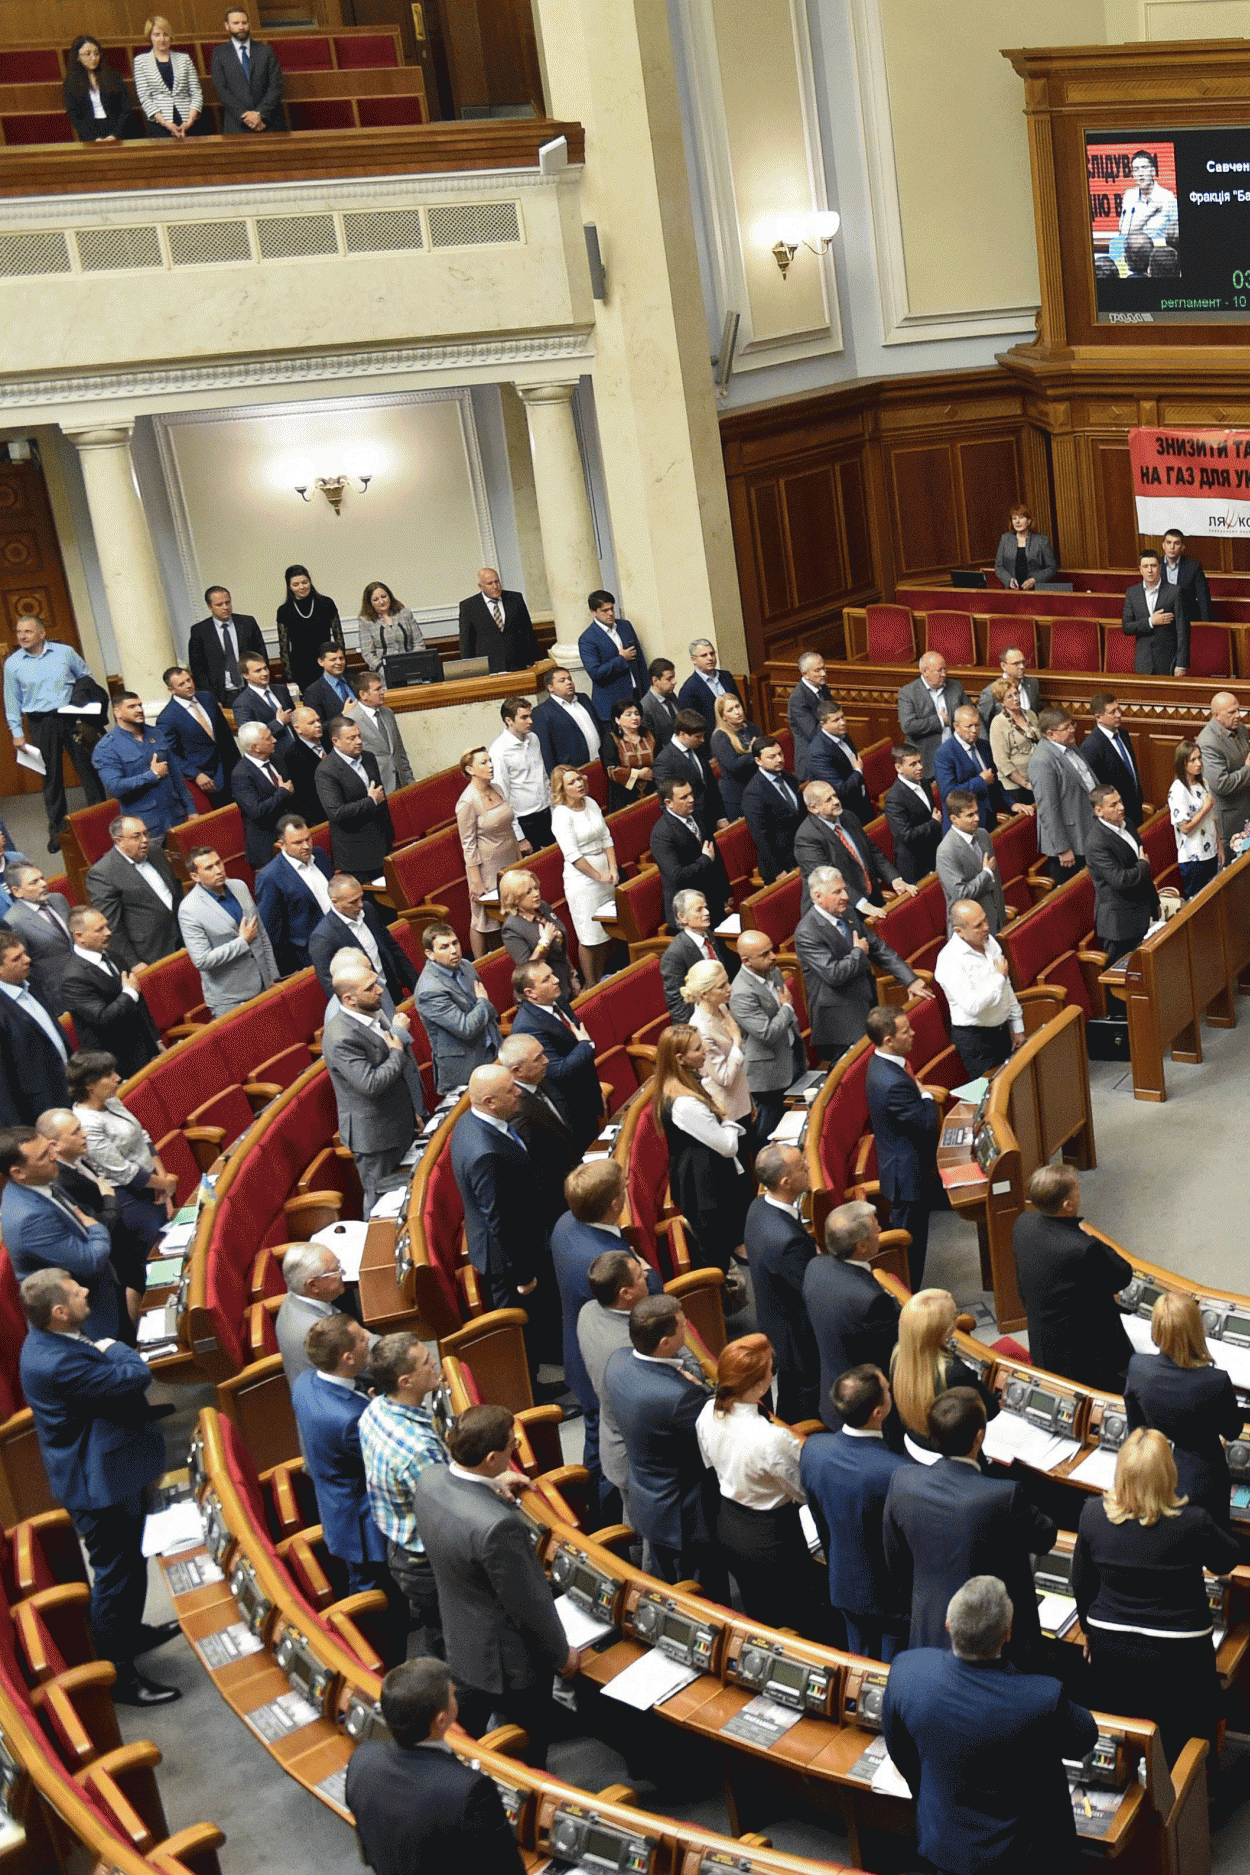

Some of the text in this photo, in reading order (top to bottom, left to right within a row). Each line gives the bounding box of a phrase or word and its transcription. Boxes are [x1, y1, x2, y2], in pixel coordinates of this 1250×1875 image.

[1189, 190, 1231, 205] Фракція
[1160, 297, 1222, 310] регламент
[1233, 296, 1247, 307] 10
[1155, 436, 1229, 459] ЗНИЗИТИ
[1141, 465, 1162, 485] НА
[1166, 466, 1195, 486] ГАЗ
[1199, 468, 1231, 489] ДЛЯ
